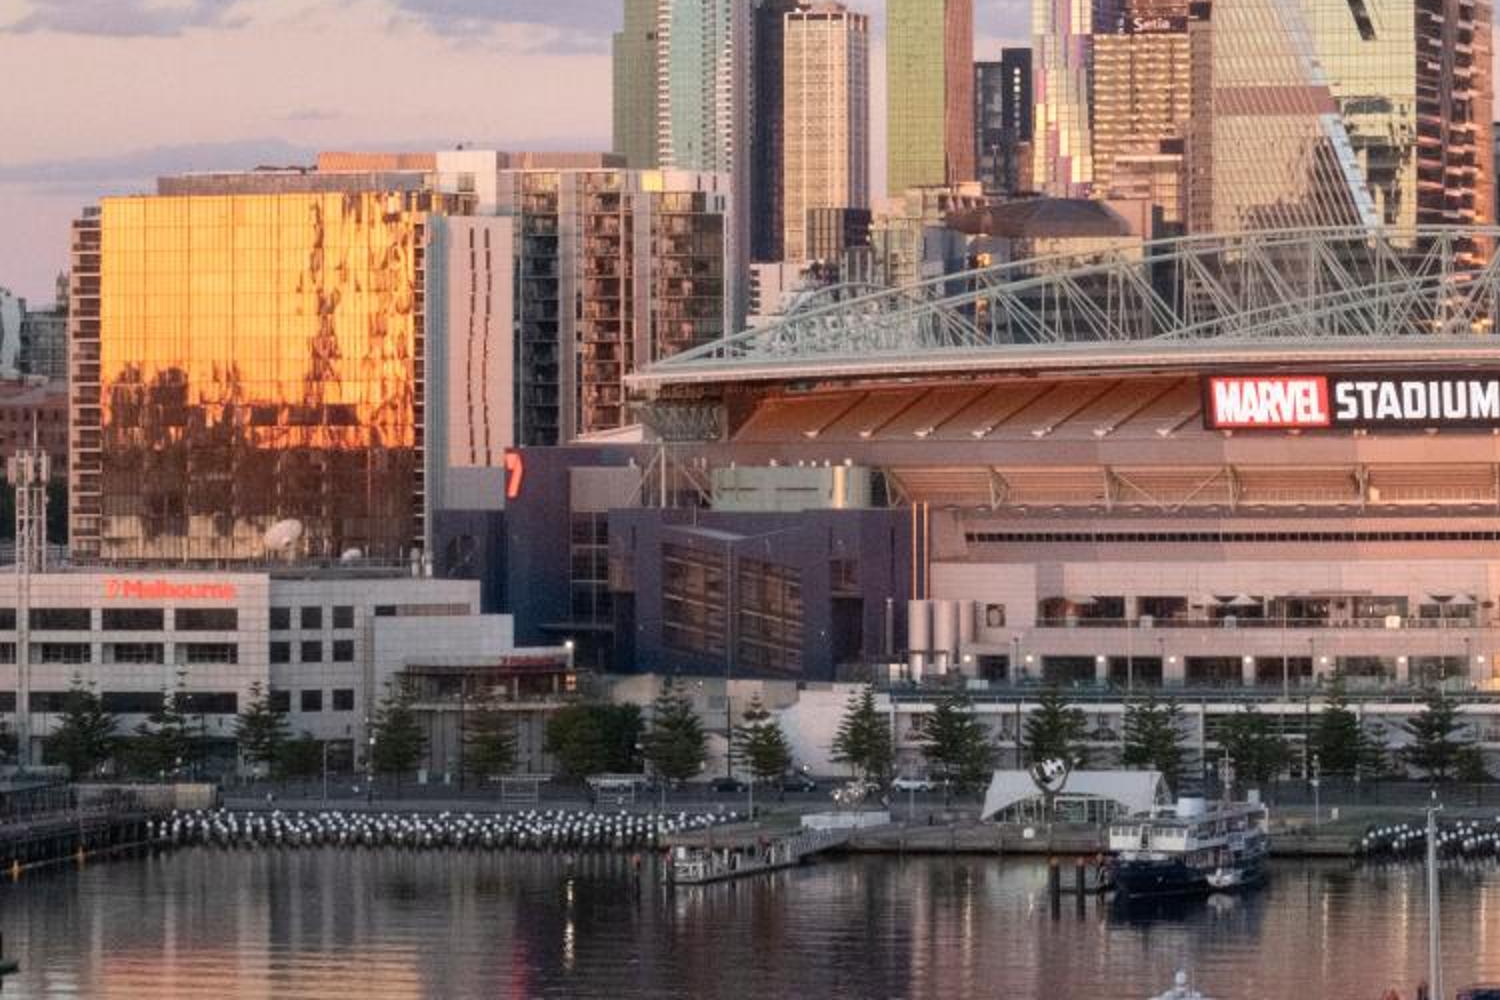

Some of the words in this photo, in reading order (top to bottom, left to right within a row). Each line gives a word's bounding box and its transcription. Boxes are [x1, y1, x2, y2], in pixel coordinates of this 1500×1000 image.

[1213, 380, 1327, 424] MARVEL
[1335, 380, 1500, 420] STADIUM
[123, 579, 236, 600] Melbourne
